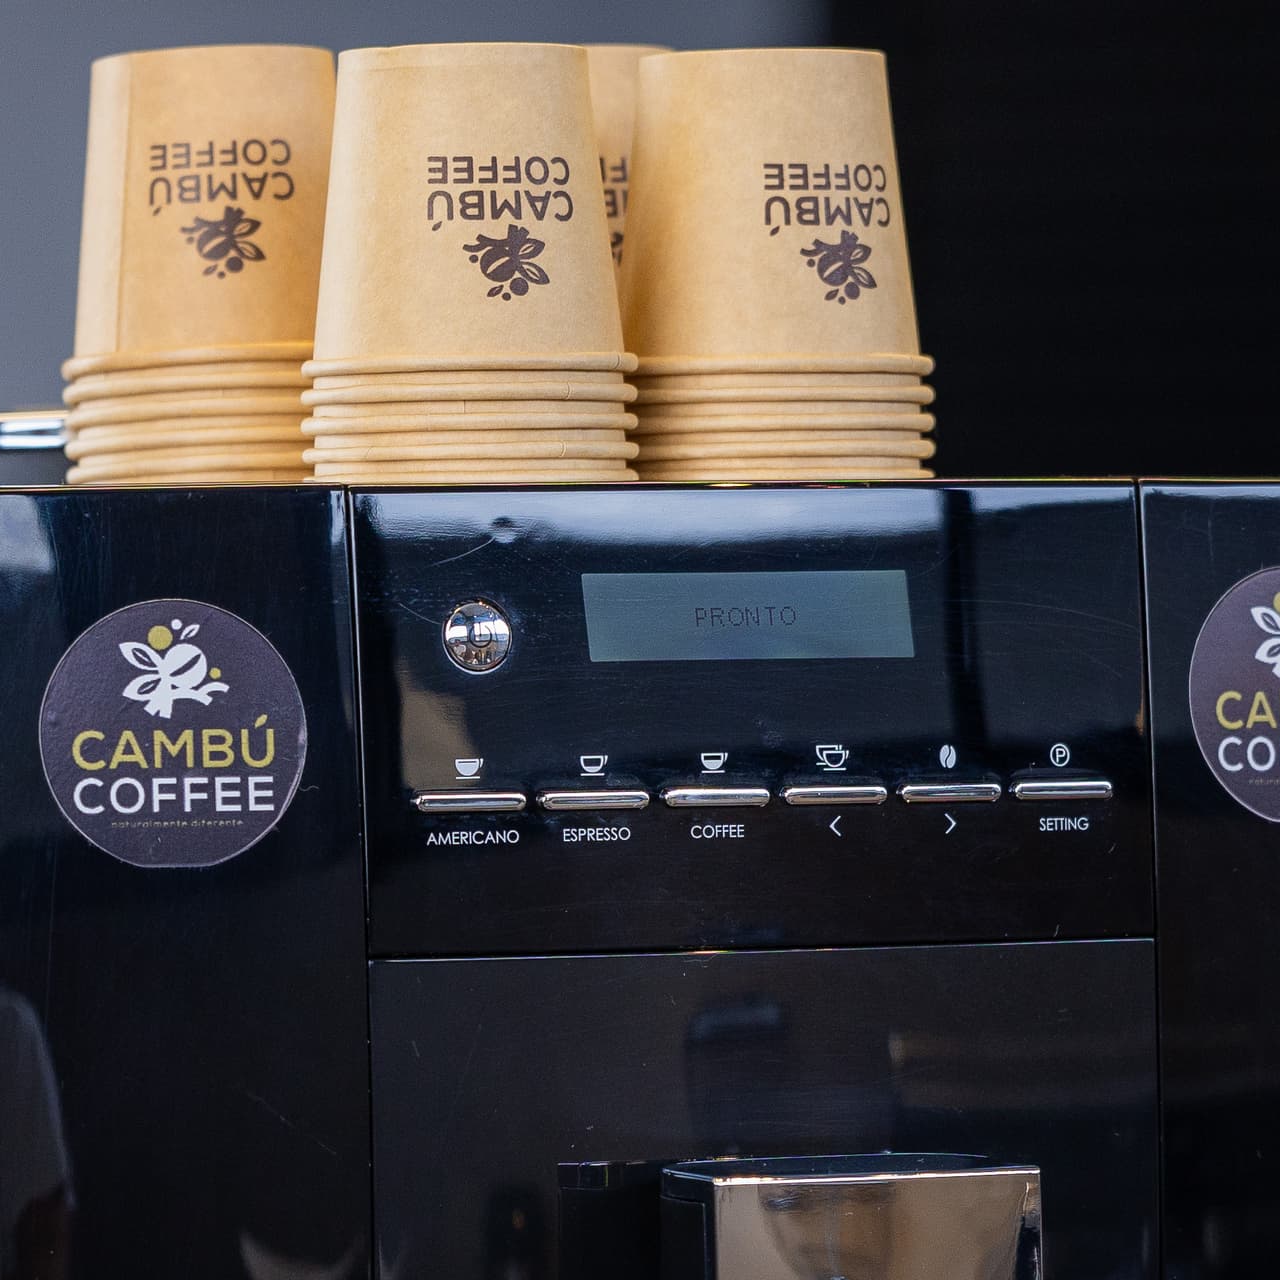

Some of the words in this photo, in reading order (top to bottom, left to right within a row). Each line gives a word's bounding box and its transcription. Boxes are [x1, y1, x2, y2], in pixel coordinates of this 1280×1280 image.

[150, 139, 291, 171] COFFEE
[427, 156, 570, 185] COFFEE
[763, 163, 887, 192] COFFEE
[149, 172, 295, 216] CAMBÚ
[427, 190, 574, 231] CAMBÚ
[764, 196, 891, 237] CAMBÚ
[695, 606, 797, 627] PRONTO
[72, 714, 275, 771] CAMBÚ
[73, 776, 276, 814] COFFEE
[426, 830, 520, 846] AMERICANO
[562, 827, 631, 843] ESPRESSO
[690, 824, 745, 840] COFFEE
[1039, 817, 1090, 832] SETTING
